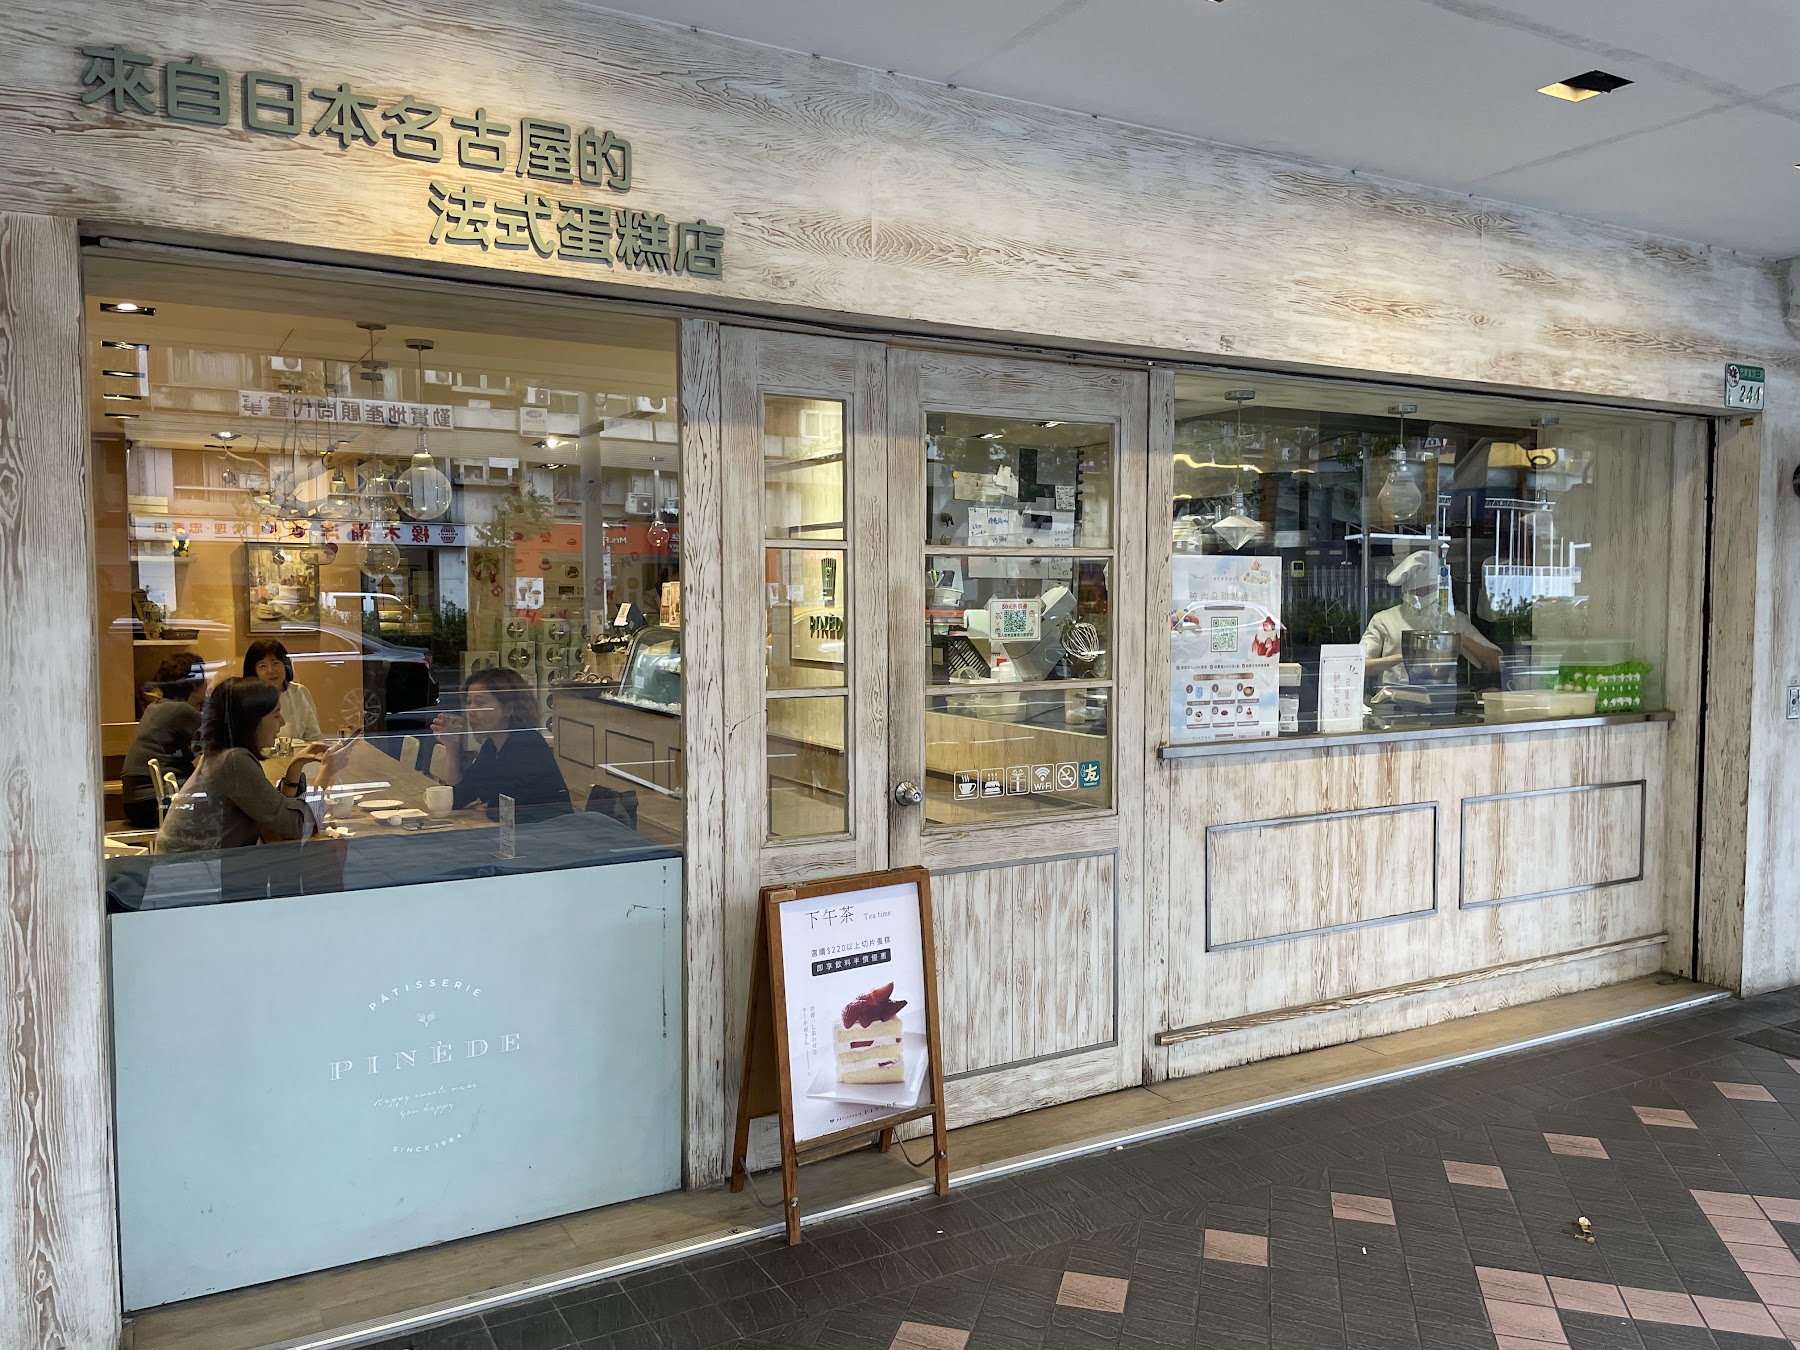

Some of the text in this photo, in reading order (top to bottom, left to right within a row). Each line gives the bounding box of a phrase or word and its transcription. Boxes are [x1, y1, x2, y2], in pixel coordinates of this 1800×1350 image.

[81, 45, 632, 192] 來自日本名古屋的
[428, 180, 725, 278] 法式蛋糕店
[1739, 385, 1761, 404] 244
[804, 905, 854, 929] 下午茶
[877, 910, 892, 918] time
[367, 978, 482, 1012] PÂTISSERIE
[328, 1032, 521, 1081] PINÈDE
[373, 1093, 410, 1109] Happy
[400, 1102, 454, 1121] you happy
[392, 1144, 431, 1153] SINCE
